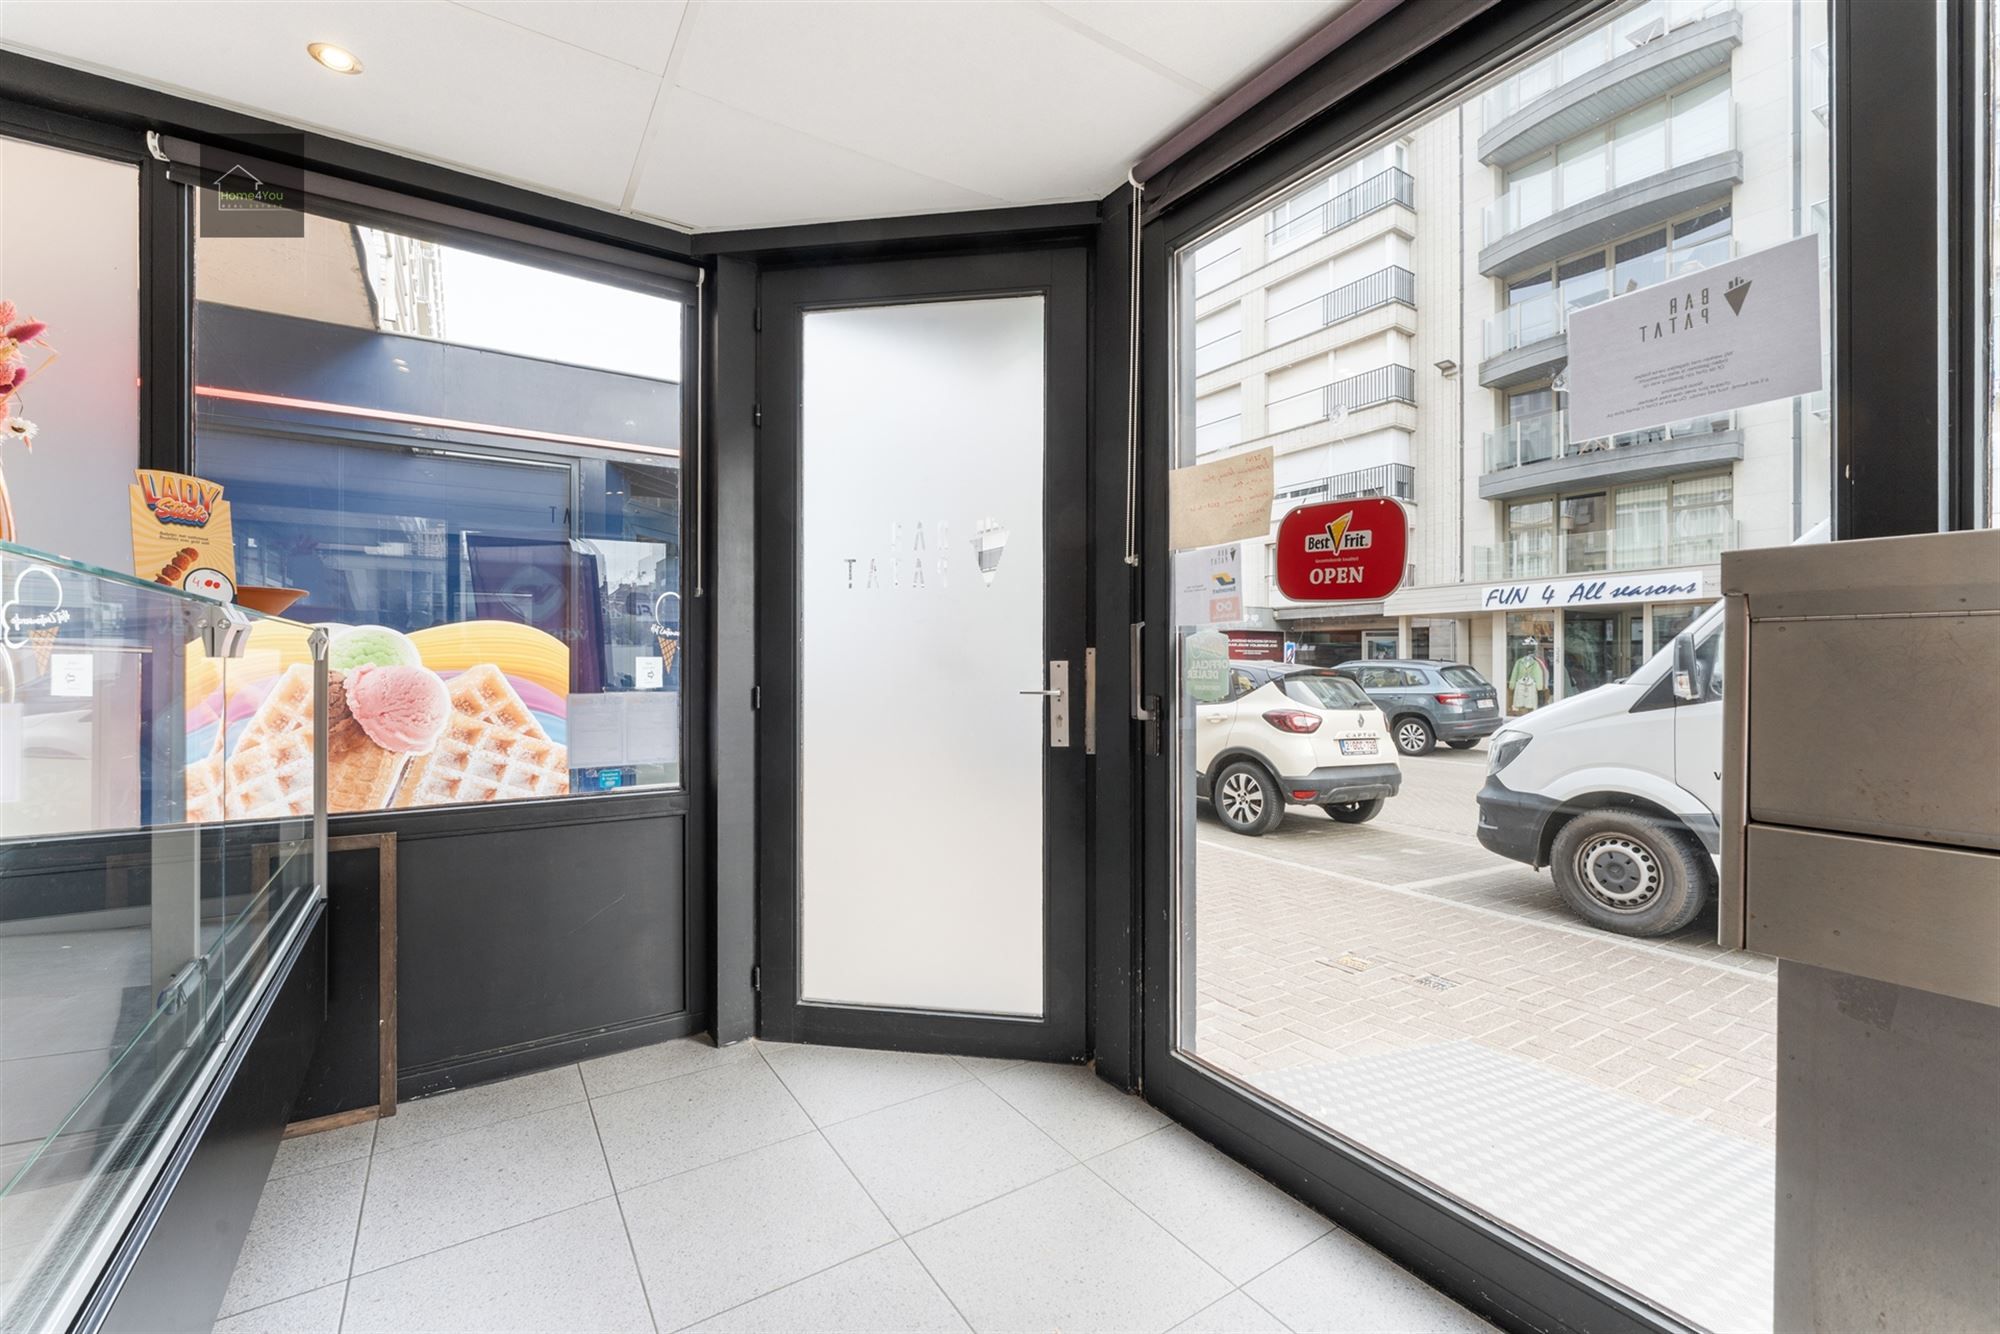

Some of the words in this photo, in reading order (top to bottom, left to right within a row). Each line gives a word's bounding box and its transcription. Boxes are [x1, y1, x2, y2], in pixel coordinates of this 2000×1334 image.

[138, 473, 222, 516] LADY
[1308, 537, 1331, 550] Best
[1344, 534, 1366, 548] Frit
[1309, 566, 1364, 585] OPEN
[1485, 585, 1530, 607] FUN
[1541, 584, 1555, 604] 4
[1567, 581, 1607, 603] All
[1609, 581, 1696, 599] seasons
